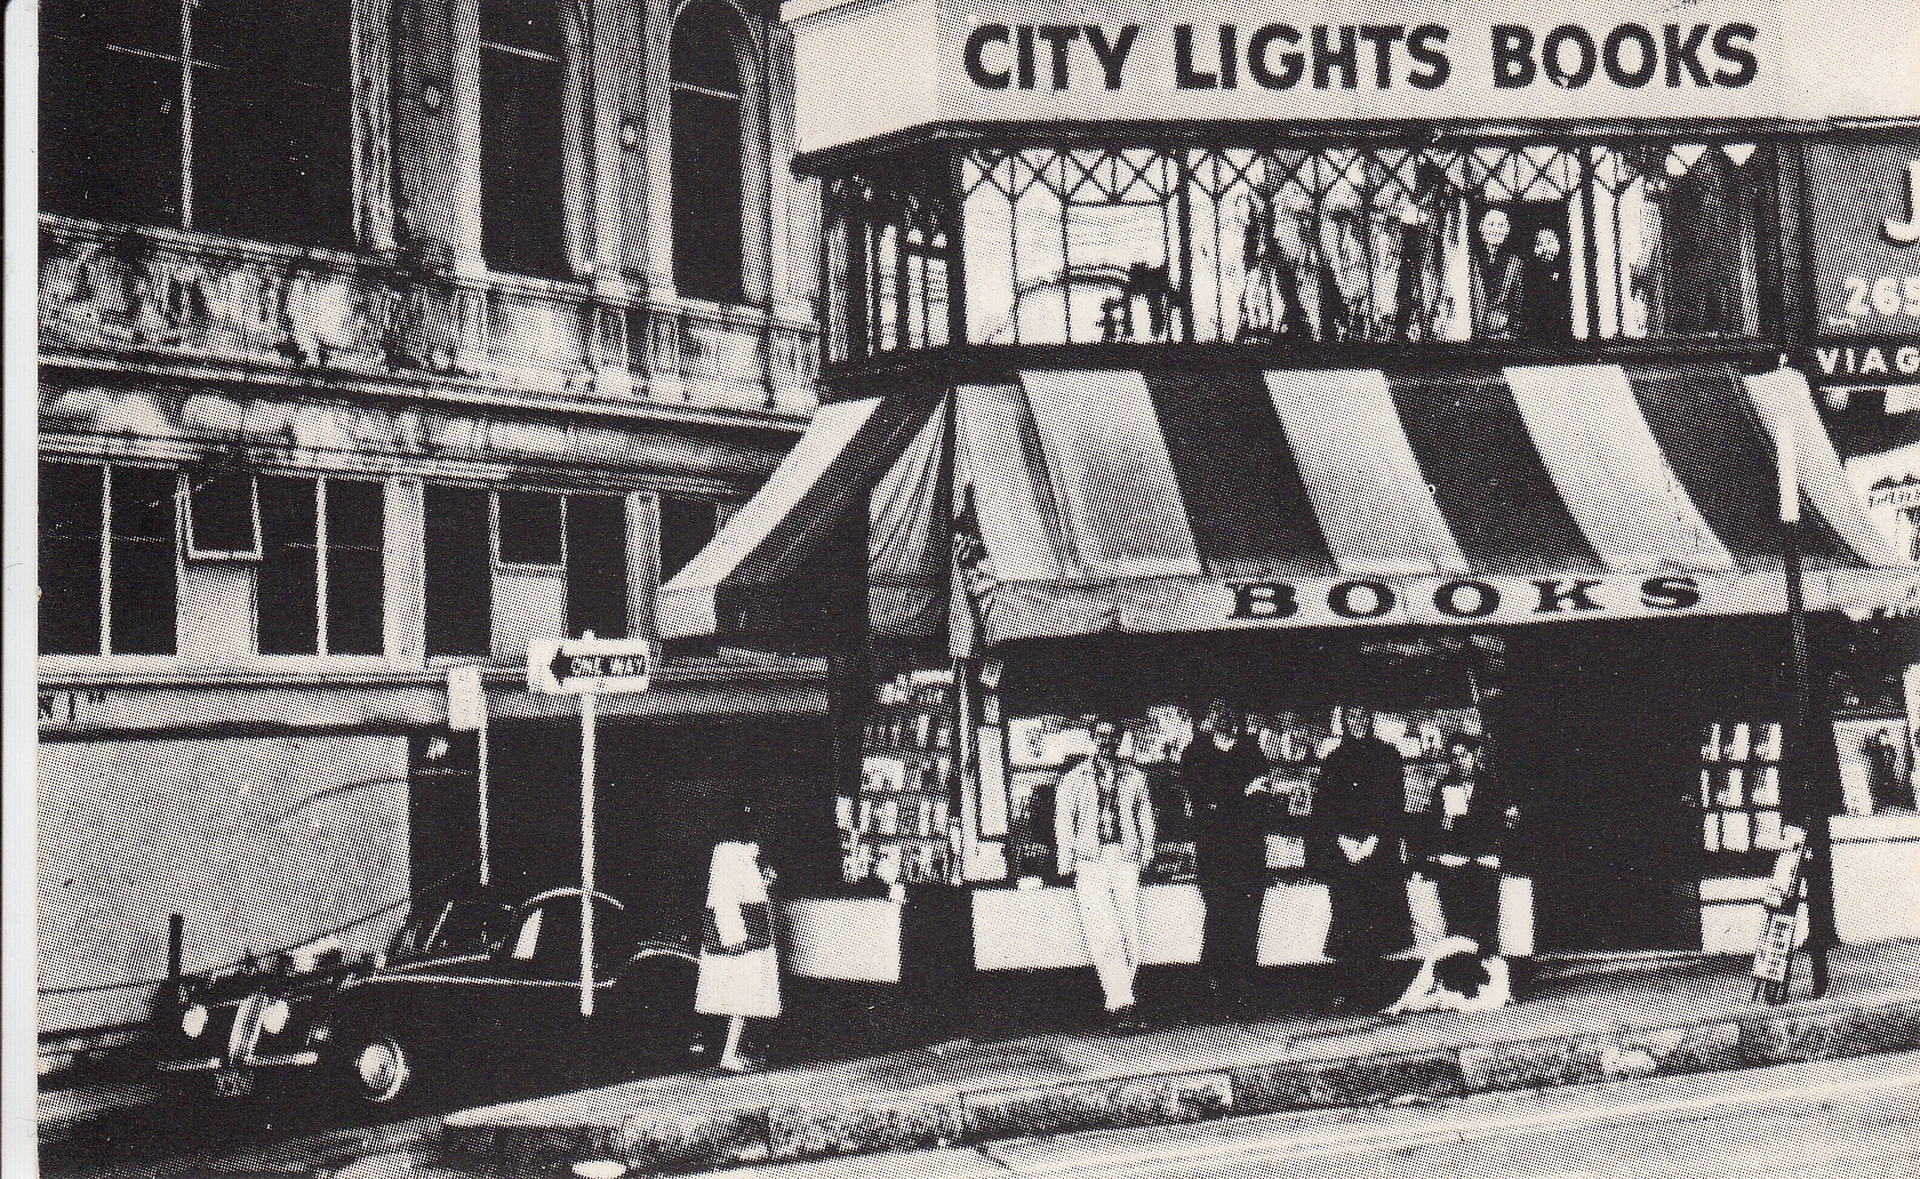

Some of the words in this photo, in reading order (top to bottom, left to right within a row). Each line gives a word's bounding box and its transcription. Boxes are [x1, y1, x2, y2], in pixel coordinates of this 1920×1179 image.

[964, 23, 1139, 90] CITY
[1174, 23, 1451, 90] LIGHTS
[1492, 22, 1759, 88] BOOKS
[1226, 575, 1701, 620] BOOKS
[571, 656, 602, 676] ONE
[609, 656, 645, 676] WAY
